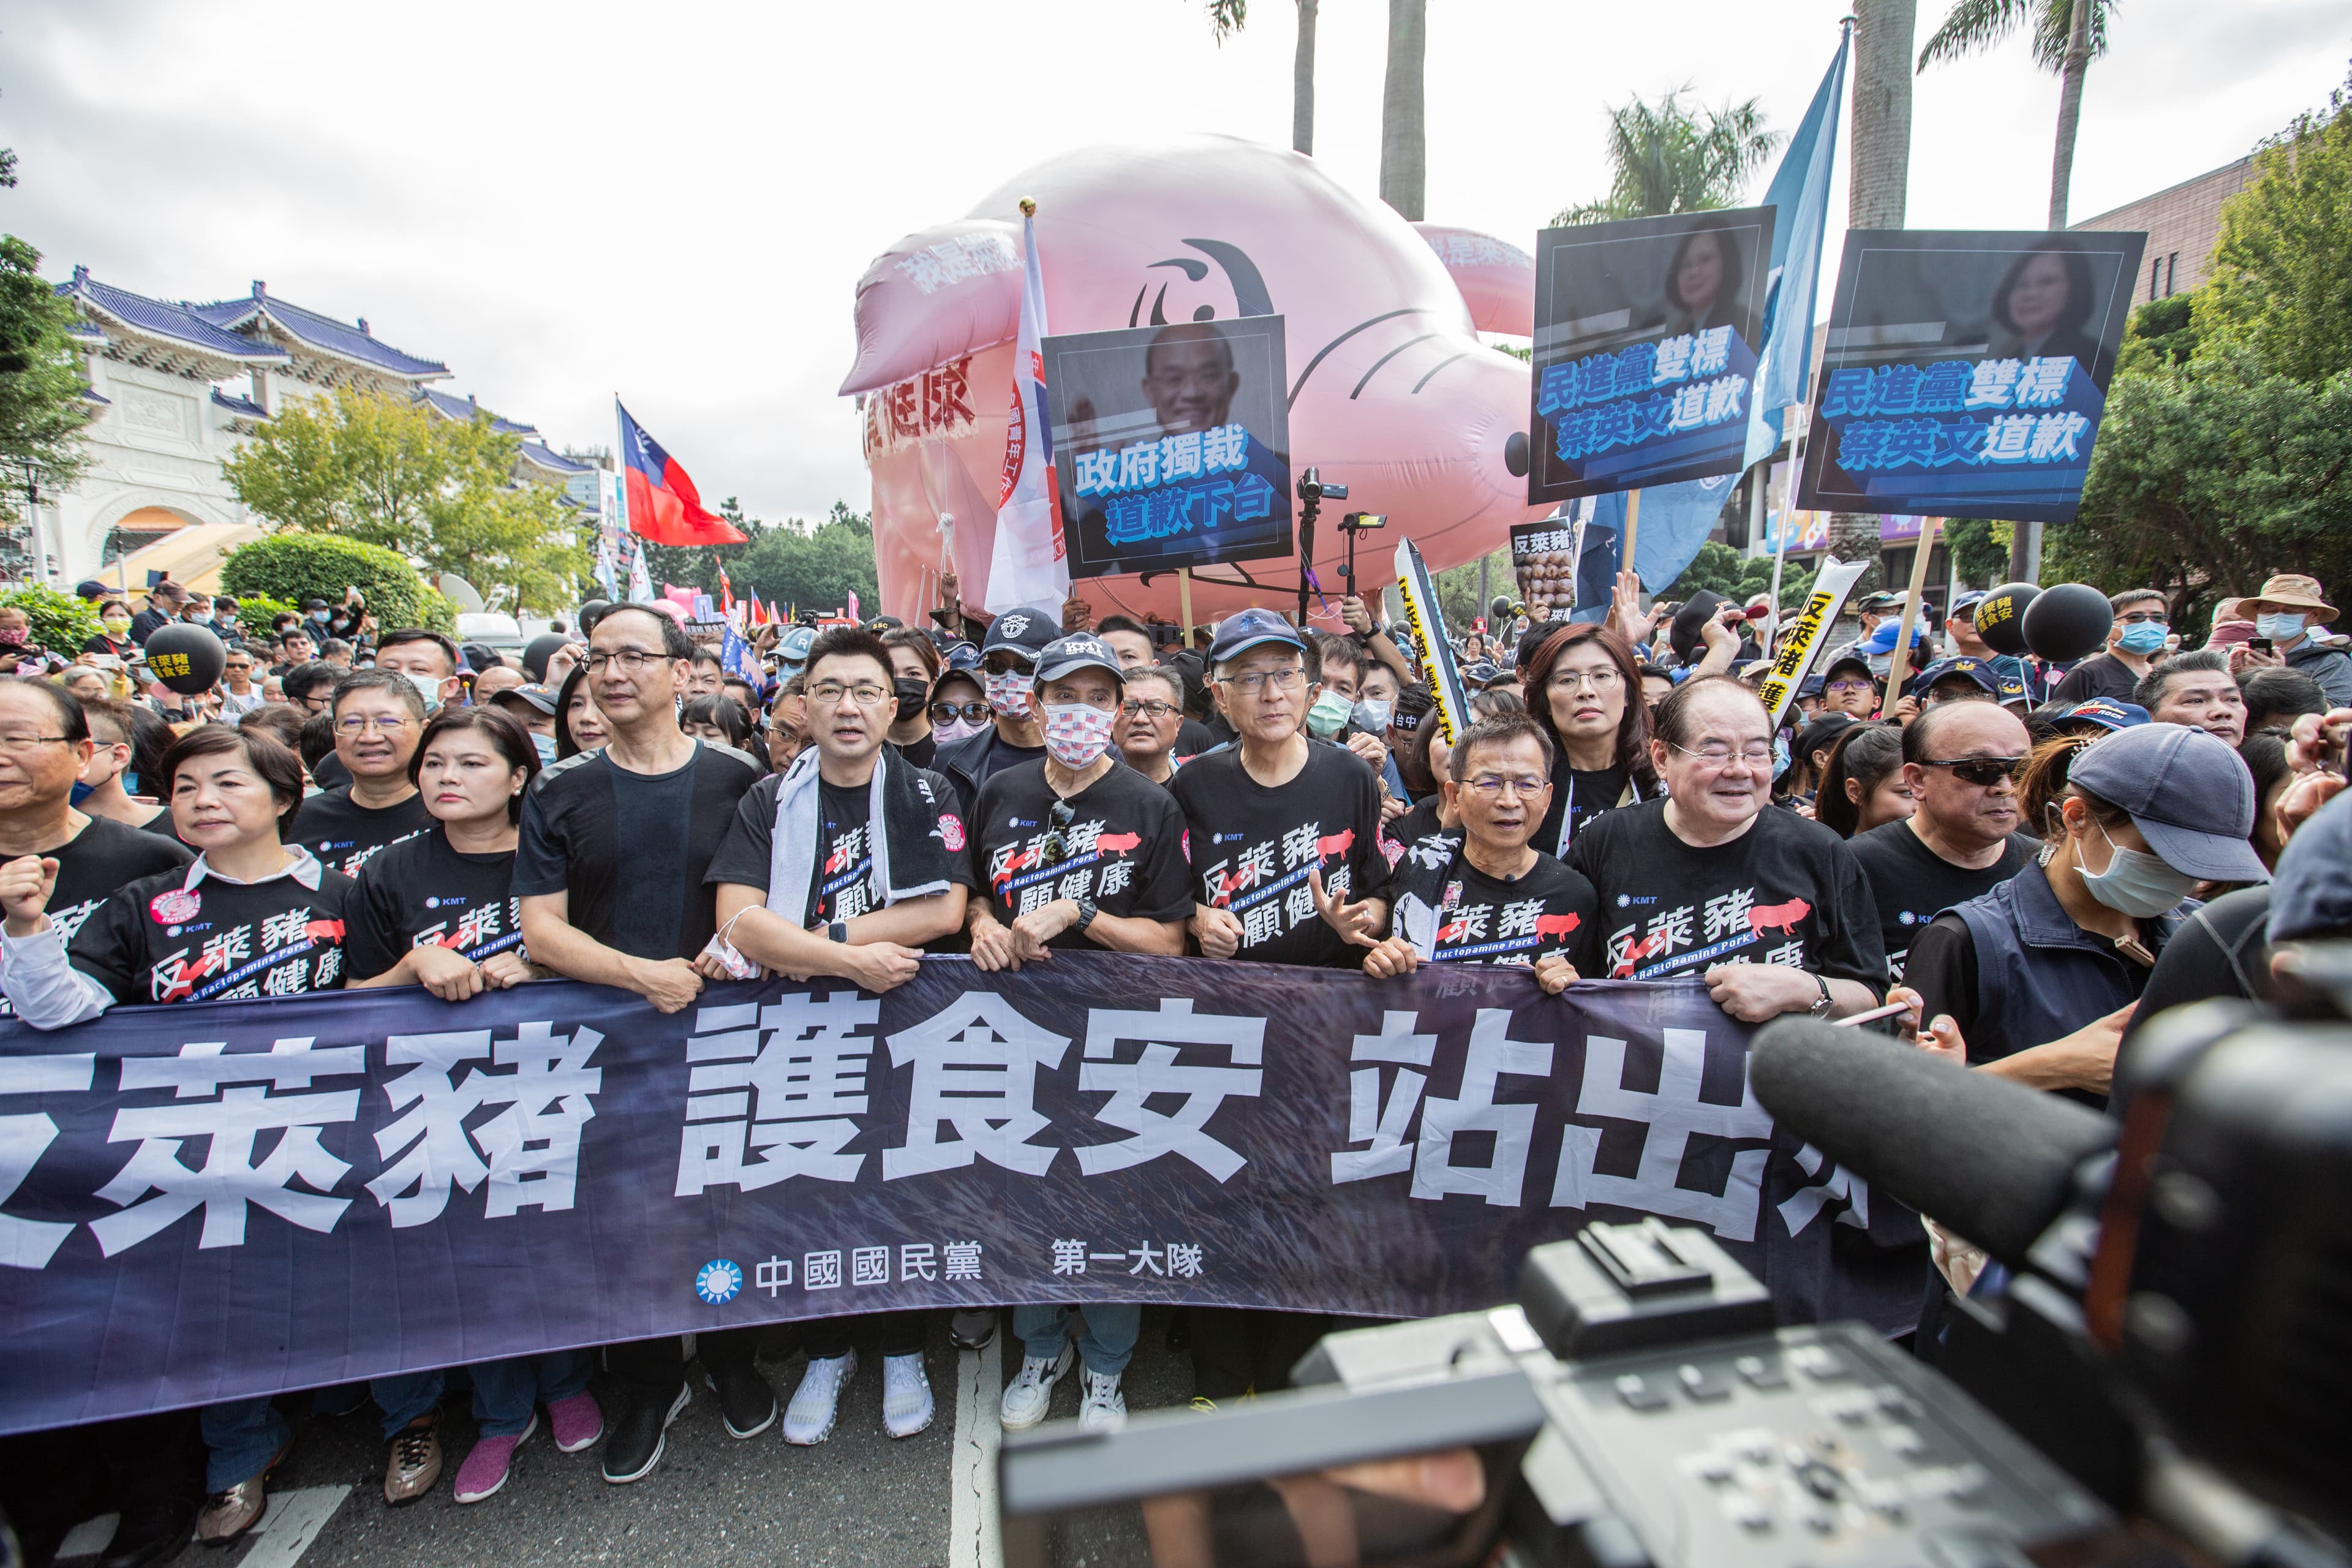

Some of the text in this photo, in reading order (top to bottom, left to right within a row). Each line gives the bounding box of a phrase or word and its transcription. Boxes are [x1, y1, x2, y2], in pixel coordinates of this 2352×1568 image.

[1537, 324, 1735, 417] 民進黨雙標
[1820, 355, 2076, 419] 民進黨雙標
[1556, 374, 1748, 461] 蔡英文道歉
[1836, 411, 2090, 470] 蔡英文道歉
[1076, 423, 1249, 498] 政府獨裁
[1105, 472, 1275, 546] 道歉下台
[1514, 529, 1572, 555] 反萊豬
[148, 653, 189, 668] 反萊豬
[1065, 641, 1102, 652] KMT
[1770, 593, 1833, 676] 反萊豬
[1396, 713, 1417, 729] 台中
[1004, 853, 1095, 891] NO Ractopamine Pork
[1018, 860, 1135, 917] 顧健康
[1203, 821, 1319, 908] 反萊豬
[1235, 876, 1295, 909] Ractopamine
[1297, 863, 1318, 878] Pork
[186, 922, 213, 933] KMT
[1243, 864, 1351, 948] 顧健康
[1444, 899, 1547, 944] 萊豬
[1632, 896, 1657, 905] KMT
[151, 907, 311, 1001] 反萊豬
[466, 931, 522, 959] ctopamine
[1435, 944, 1506, 960] Ractopamine
[1509, 937, 1534, 948] Pork
[1607, 887, 1754, 979] 反萊豬
[1640, 947, 1717, 980] Ractopamine
[1721, 935, 1750, 951] Pork
[202, 954, 275, 997] Ractopamine
[279, 941, 307, 959] Pork
[674, 990, 1268, 1197] 護食安
[756, 1238, 1204, 1298] 中國國民黨 第一大隊
